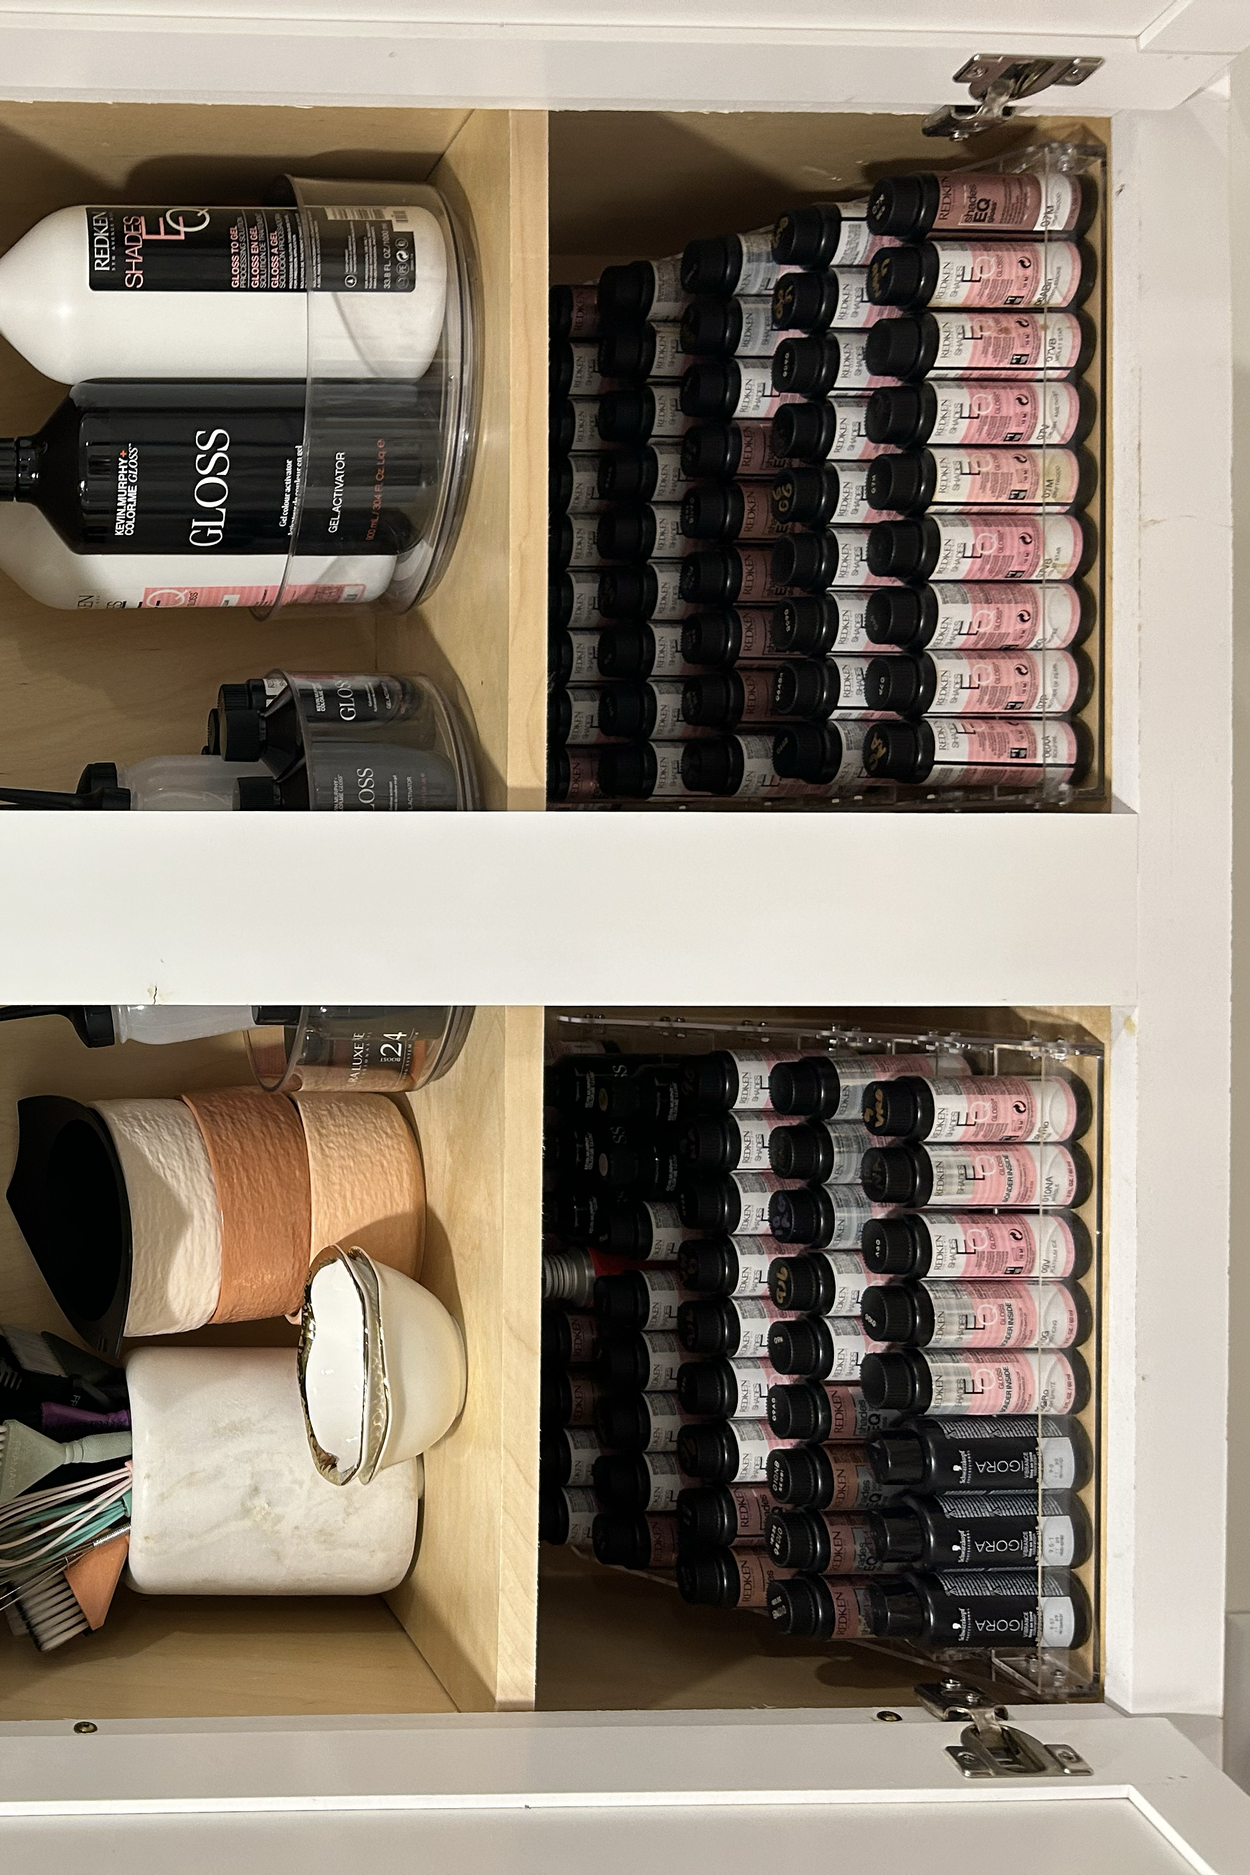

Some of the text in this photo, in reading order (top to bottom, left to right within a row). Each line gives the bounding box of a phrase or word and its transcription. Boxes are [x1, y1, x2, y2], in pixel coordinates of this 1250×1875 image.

[939, 177, 951, 220] REDKEN
[964, 184, 977, 223] shades
[974, 198, 991, 223] EQ
[92, 211, 110, 270] REDKEN
[123, 216, 144, 288] SHADES
[237, 216, 247, 288] PROCESSING SOLUTION
[270, 231, 278, 246] GEL
[230, 225, 240, 288] GLOSS TO GEL
[250, 226, 259, 288] GLOSS EN GEL
[271, 256, 279, 288] GLOSS
[940, 322, 950, 359] REDKEN
[934, 399, 948, 436] REDKEN
[125, 446, 138, 536] COLOR.ME GLOSS
[188, 428, 230, 546] GLOSS
[328, 452, 346, 533] GEL.ACTIVATOR
[938, 457, 948, 493] REDKEN
[1042, 479, 1054, 498] 07M
[279, 459, 292, 527] Gel colour activator
[842, 664, 851, 698] REDKEN
[351, 1043, 364, 1070] LUXE
[380, 1032, 407, 1056] 24
[935, 1161, 945, 1196] REDKEN
[1002, 1153, 1013, 1176] INSIDE
[934, 1234, 944, 1271] REDKEN
[948, 1238, 956, 1269] SHADES
[832, 1390, 846, 1433] REDKEN
[958, 1450, 967, 1483] Schwarzkopf
[975, 1459, 1024, 1472] IGORA
[958, 1530, 967, 1562] Schwarzkopf
[974, 1539, 1023, 1552] IGORA
[958, 1608, 967, 1641] Schwarzkopf
[974, 1620, 1024, 1631] IGORA
